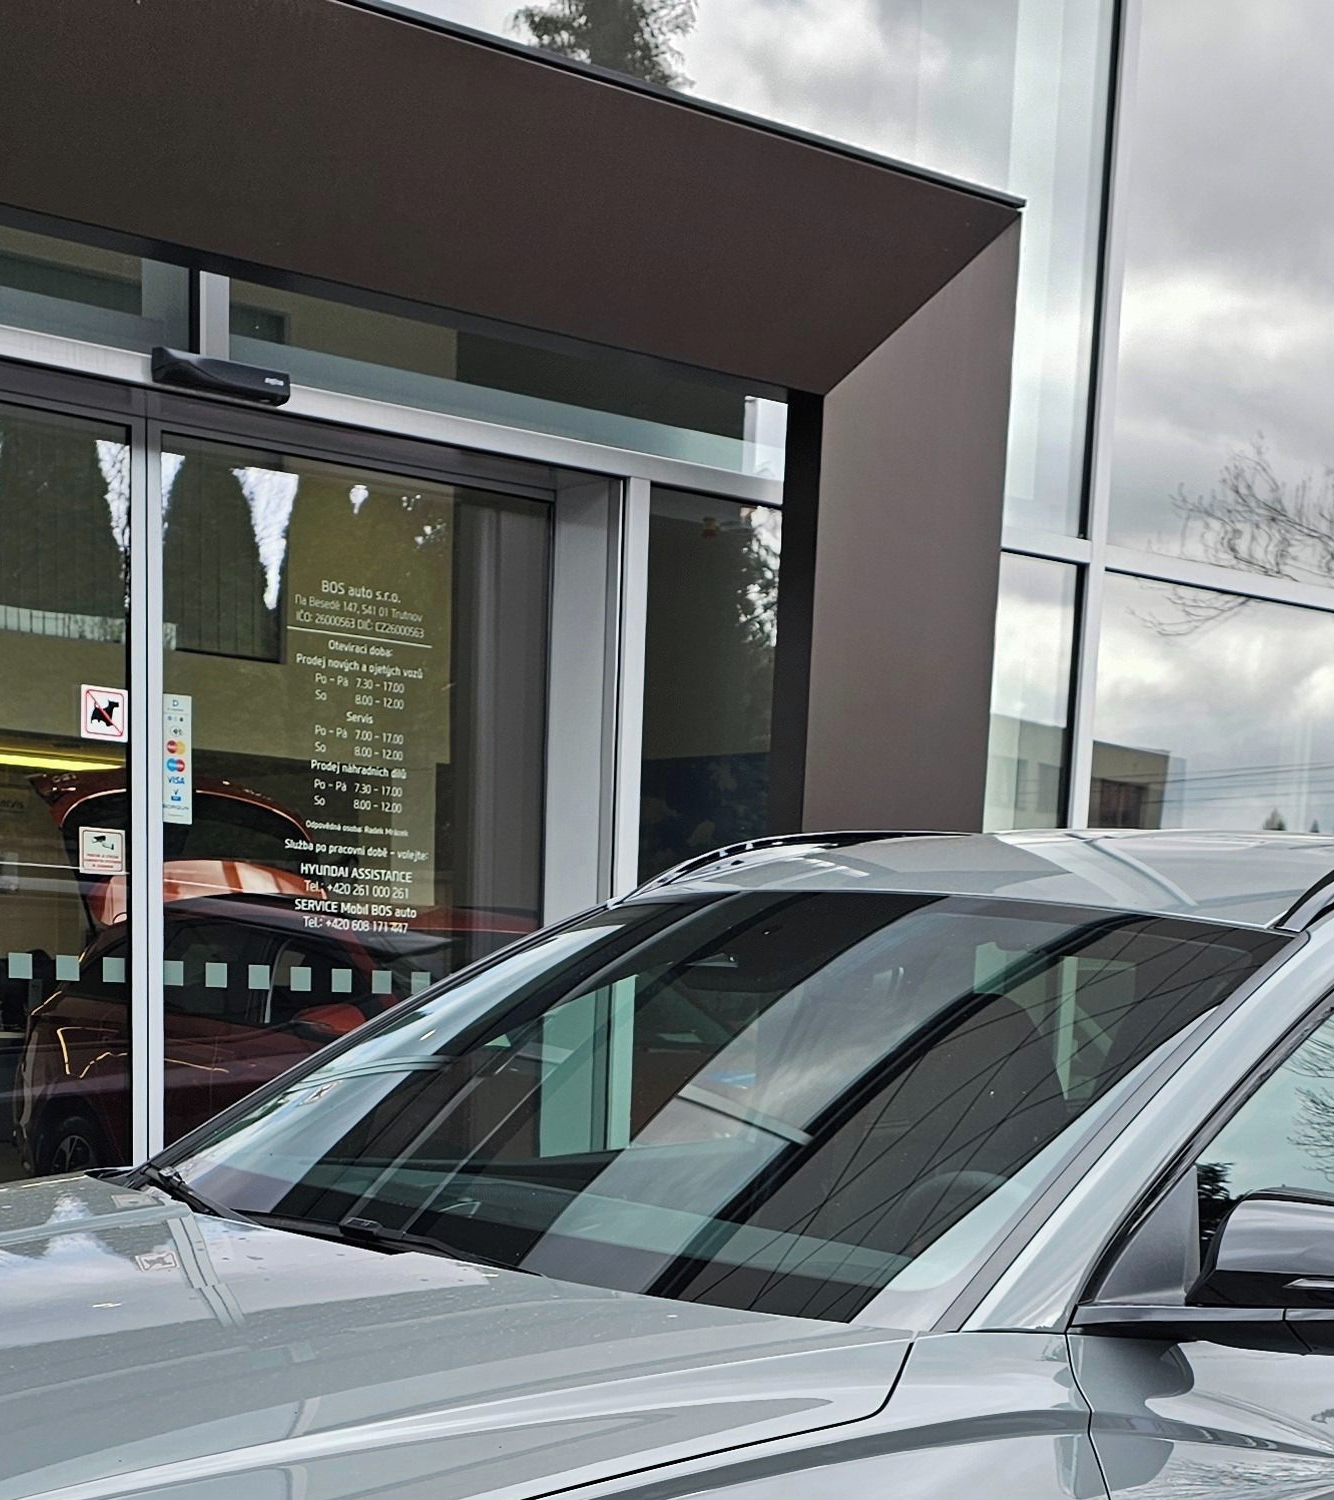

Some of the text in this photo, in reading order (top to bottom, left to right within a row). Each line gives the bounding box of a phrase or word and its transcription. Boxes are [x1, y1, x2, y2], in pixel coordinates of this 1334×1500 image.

[321, 579, 401, 604] BOS auto s.r.o.
[295, 594, 423, 623] Na Besedě 147, 541 01 Trutnov
[315, 613, 355, 629] 26000563
[295, 653, 326, 669] Prodej
[328, 658, 360, 673] nových
[361, 663, 367, 671] a
[368, 663, 401, 678] ojetých
[315, 673, 327, 684] Po
[337, 675, 349, 687] Pá
[355, 677, 374, 690] 7.30
[382, 681, 405, 694] 17.00
[315, 689, 327, 701] So
[354, 694, 373, 707] 8.00
[383, 697, 405, 710] 12.00
[346, 711, 374, 725] Servis
[314, 724, 327, 736] Po
[336, 727, 348, 739] Pá
[354, 729, 373, 742] 7.00
[382, 733, 404, 745] 17.00
[314, 741, 327, 753] So
[354, 746, 373, 758] 8.00
[382, 748, 404, 761] 12.00
[310, 759, 341, 775] Prodej
[342, 762, 389, 778] náhradních
[168, 776, 185, 785] VISA
[313, 778, 326, 790] Po
[335, 781, 347, 792] Pá
[353, 782, 372, 795] 7.30
[381, 785, 403, 798] 17.00
[313, 795, 326, 806] So
[353, 799, 372, 811] 8.00
[381, 801, 403, 814] 12.00
[284, 838, 314, 851] Služba
[315, 843, 327, 854] po
[328, 844, 365, 856] pracovní
[367, 846, 388, 858] době
[397, 849, 429, 863] volejte:
[300, 862, 413, 883] HYUNDAI ASSISTANCE
[327, 883, 351, 895] +420
[352, 884, 369, 897] 261
[372, 886, 390, 898] 000
[392, 887, 409, 899] 261
[294, 898, 417, 919] SERVICE Mobil BOS auto
[325, 917, 350, 930] +420
[372, 920, 388, 933] 171
